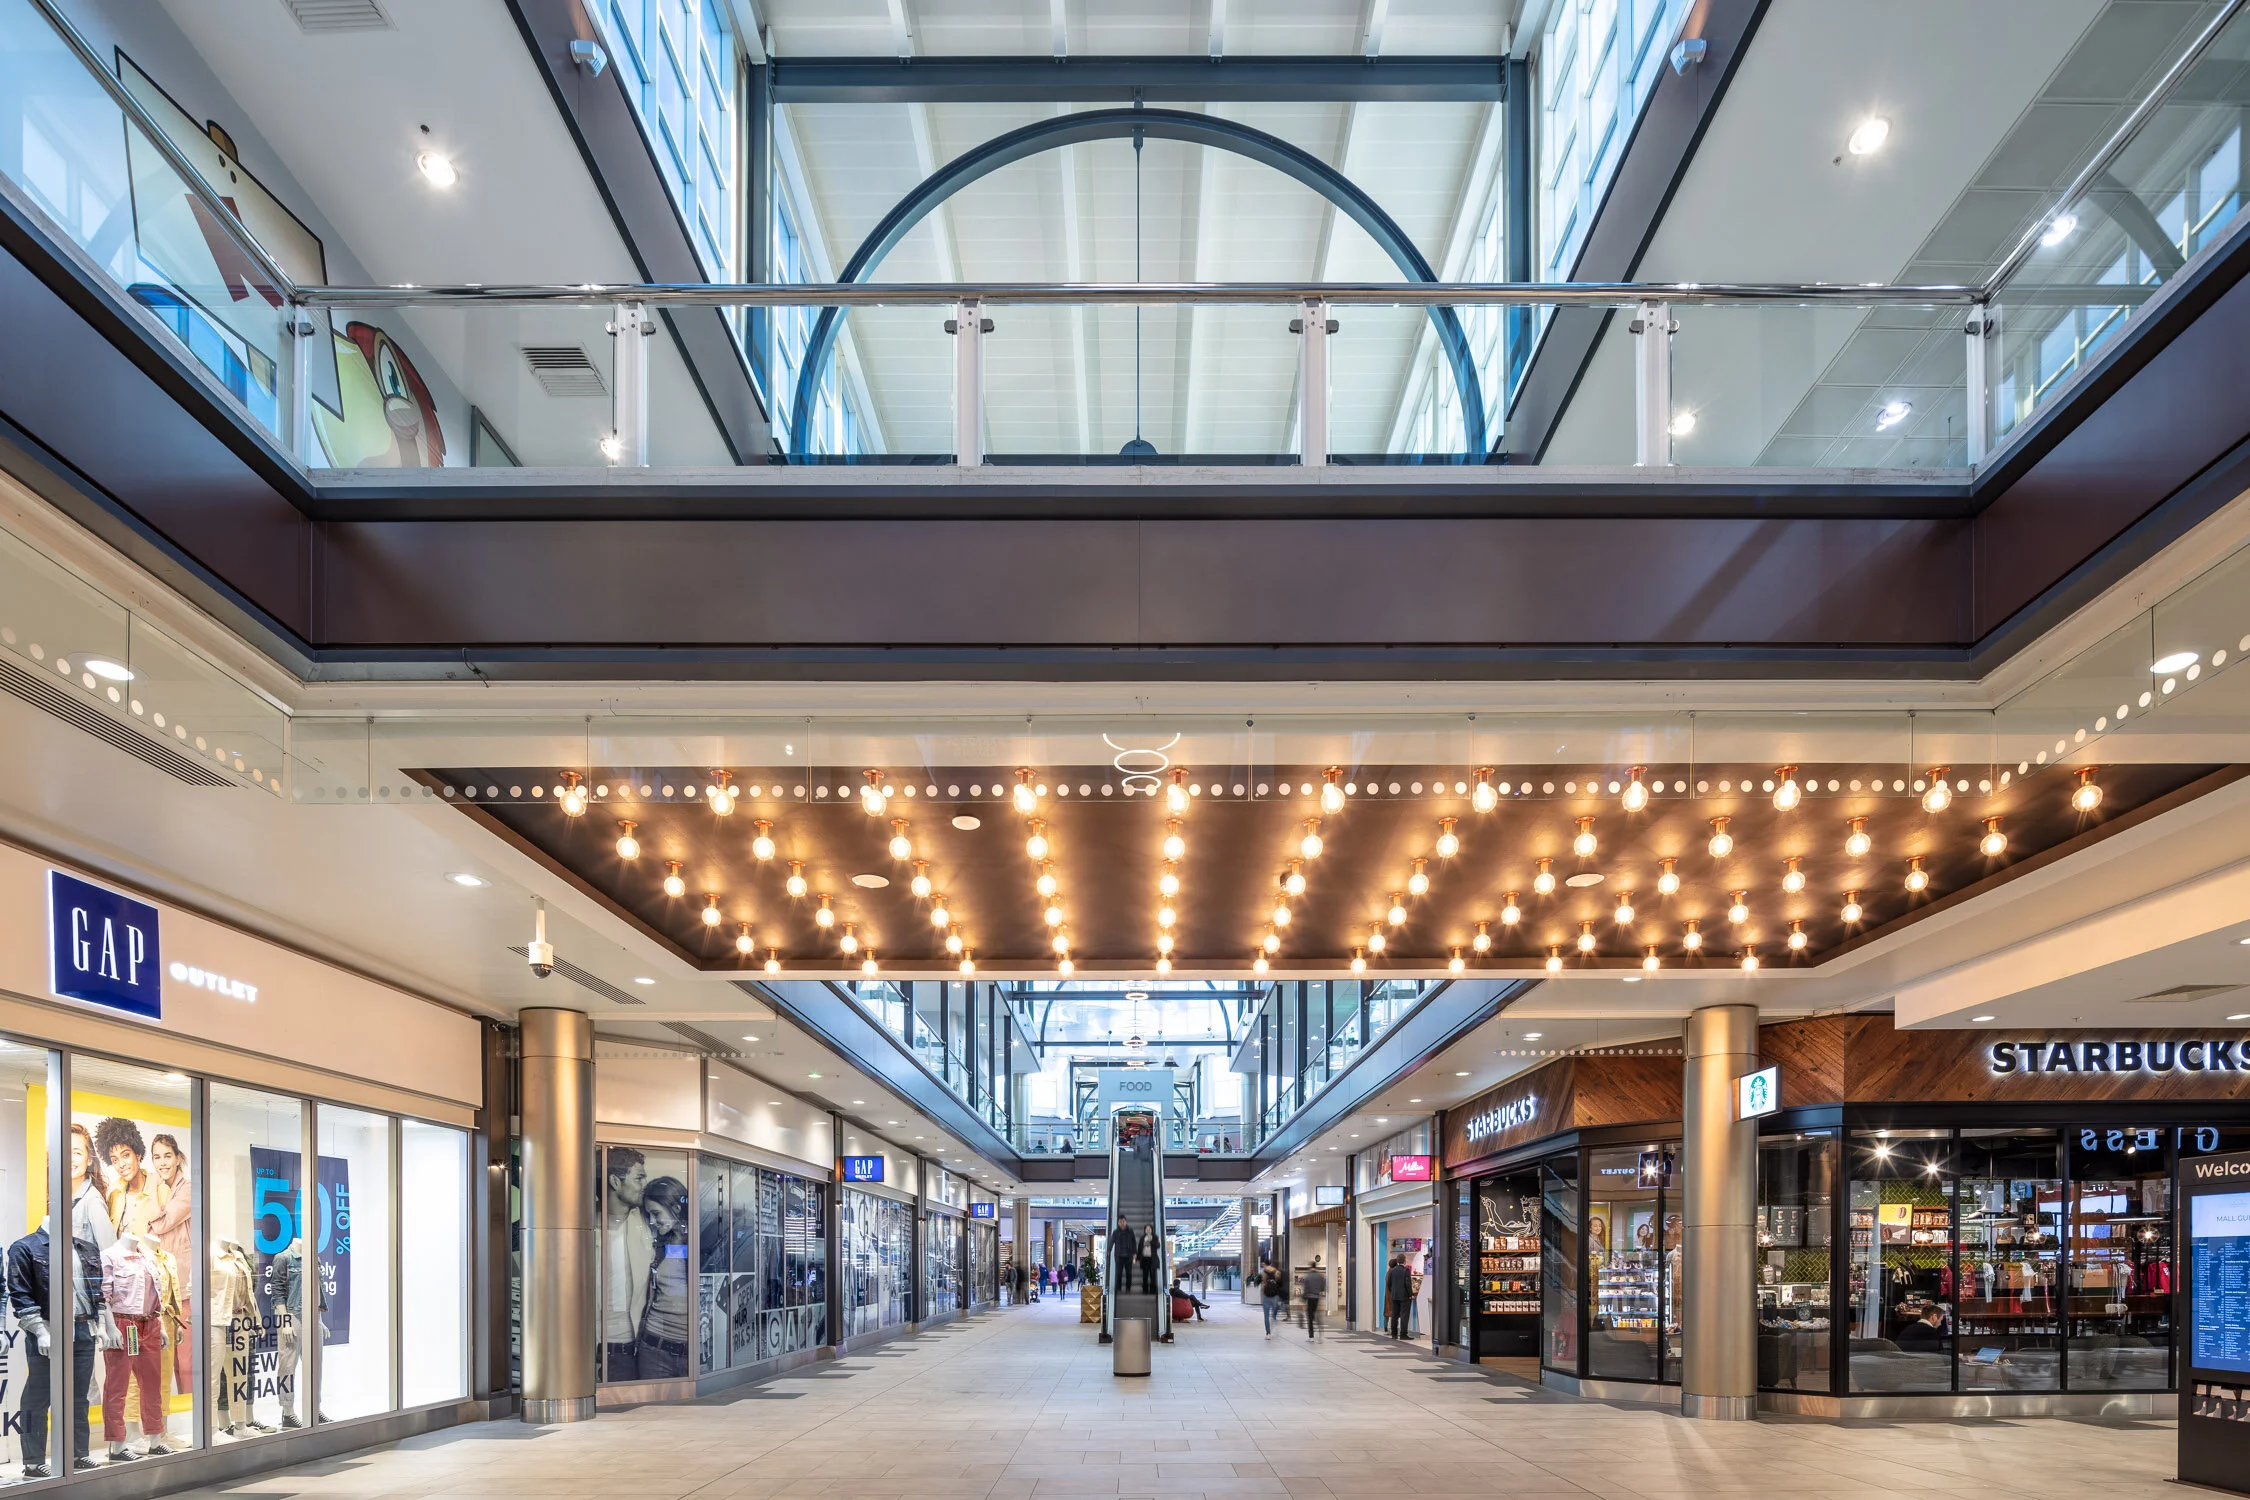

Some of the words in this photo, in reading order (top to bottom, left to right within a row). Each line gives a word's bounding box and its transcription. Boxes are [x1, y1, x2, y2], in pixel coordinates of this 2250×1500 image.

[72, 906, 144, 985] GAP
[169, 961, 258, 1003] OUTLET
[1119, 1081, 1152, 1091] FOOD
[1465, 1095, 1532, 1141] STARBUCKS
[855, 1159, 873, 1175] GAP
[254, 1176, 332, 1255] 50
[335, 1182, 350, 1230] OFF
[2216, 1215, 2236, 1223] MALL
[231, 1314, 292, 1332] COLOUR
[231, 1333, 246, 1352] IS
[249, 1334, 278, 1349] THE
[232, 1352, 279, 1377] NEW
[233, 1374, 295, 1402] KHAKI
